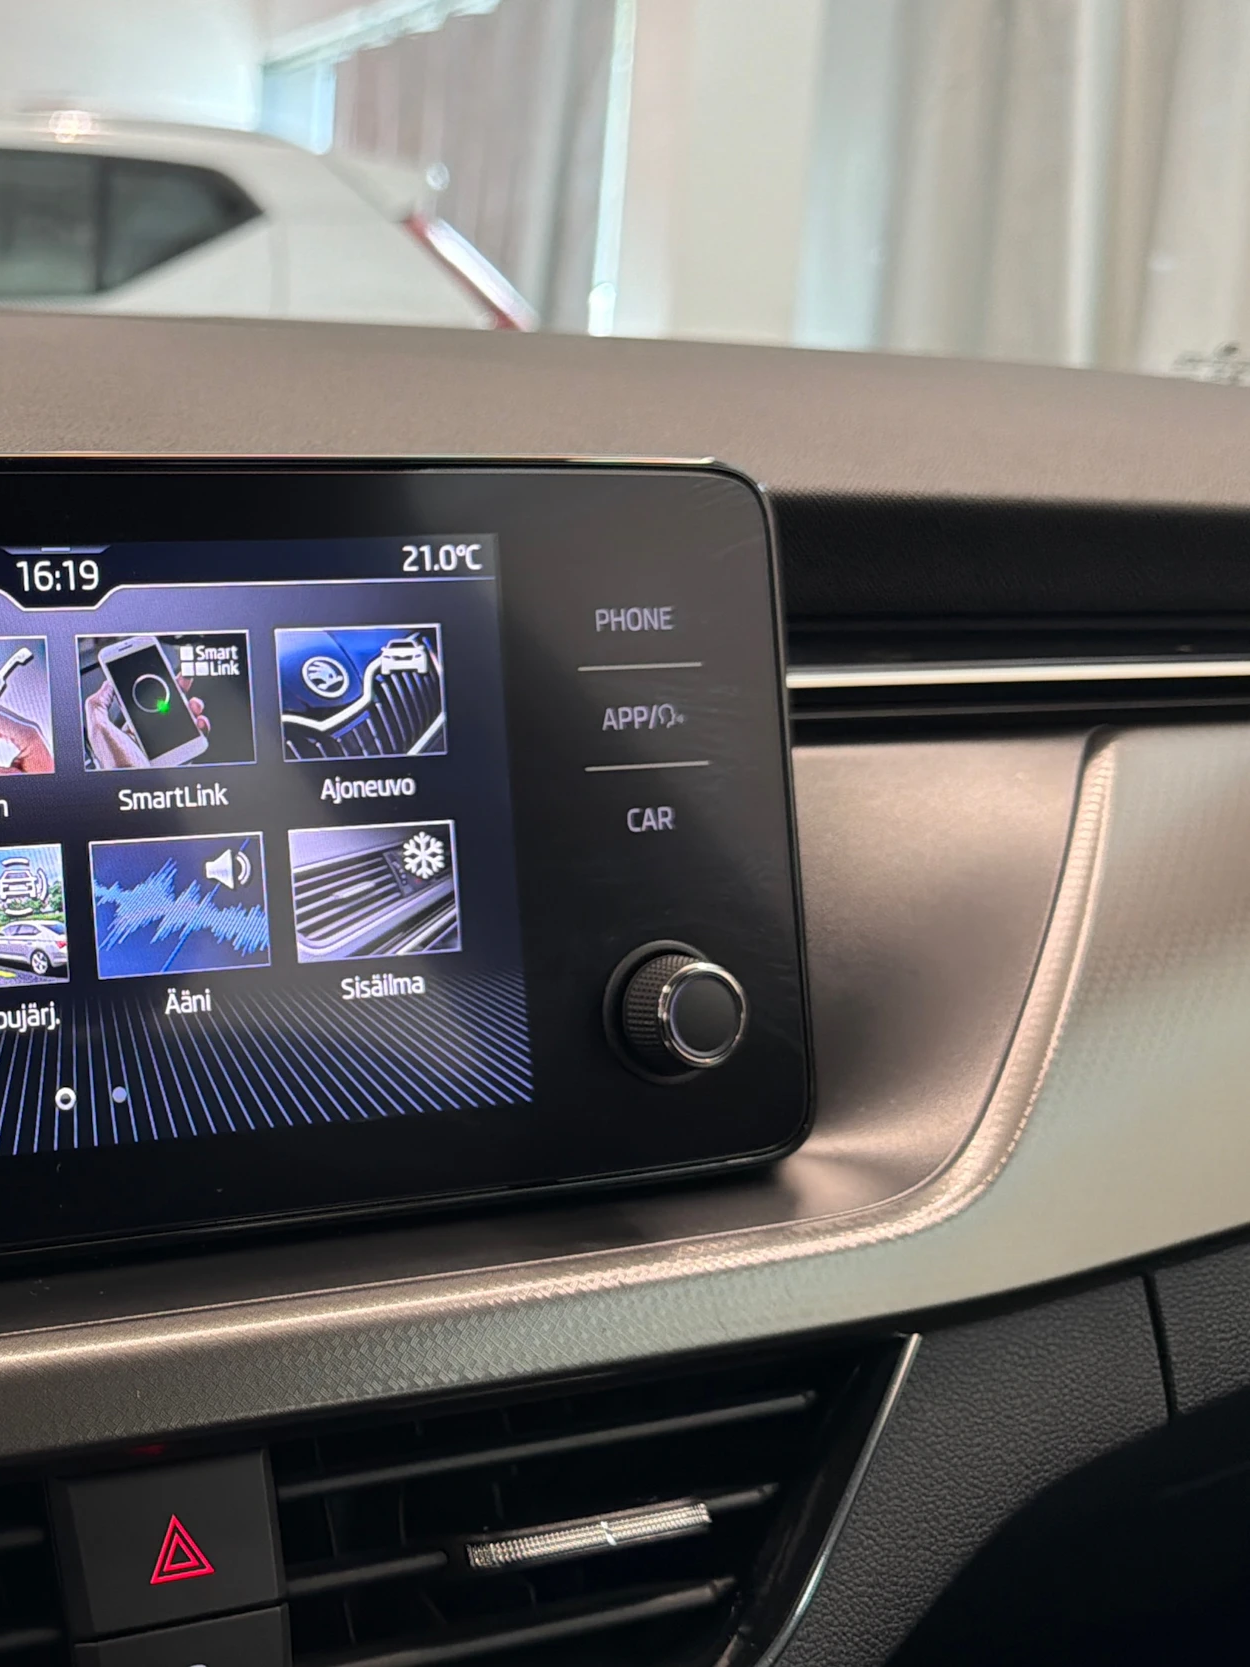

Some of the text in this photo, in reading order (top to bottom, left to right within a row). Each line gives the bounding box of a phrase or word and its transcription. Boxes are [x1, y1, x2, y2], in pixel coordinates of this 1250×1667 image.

[15, 559, 101, 592] 16:19
[595, 606, 674, 631] PHONE
[195, 644, 238, 661] Smart
[209, 661, 240, 677] Link
[118, 783, 229, 811] SmartLink
[321, 775, 416, 803] Ajoneuvo
[626, 806, 674, 832] CAR
[341, 973, 425, 1001] Sisäilma
[164, 988, 212, 1015] Ääni
